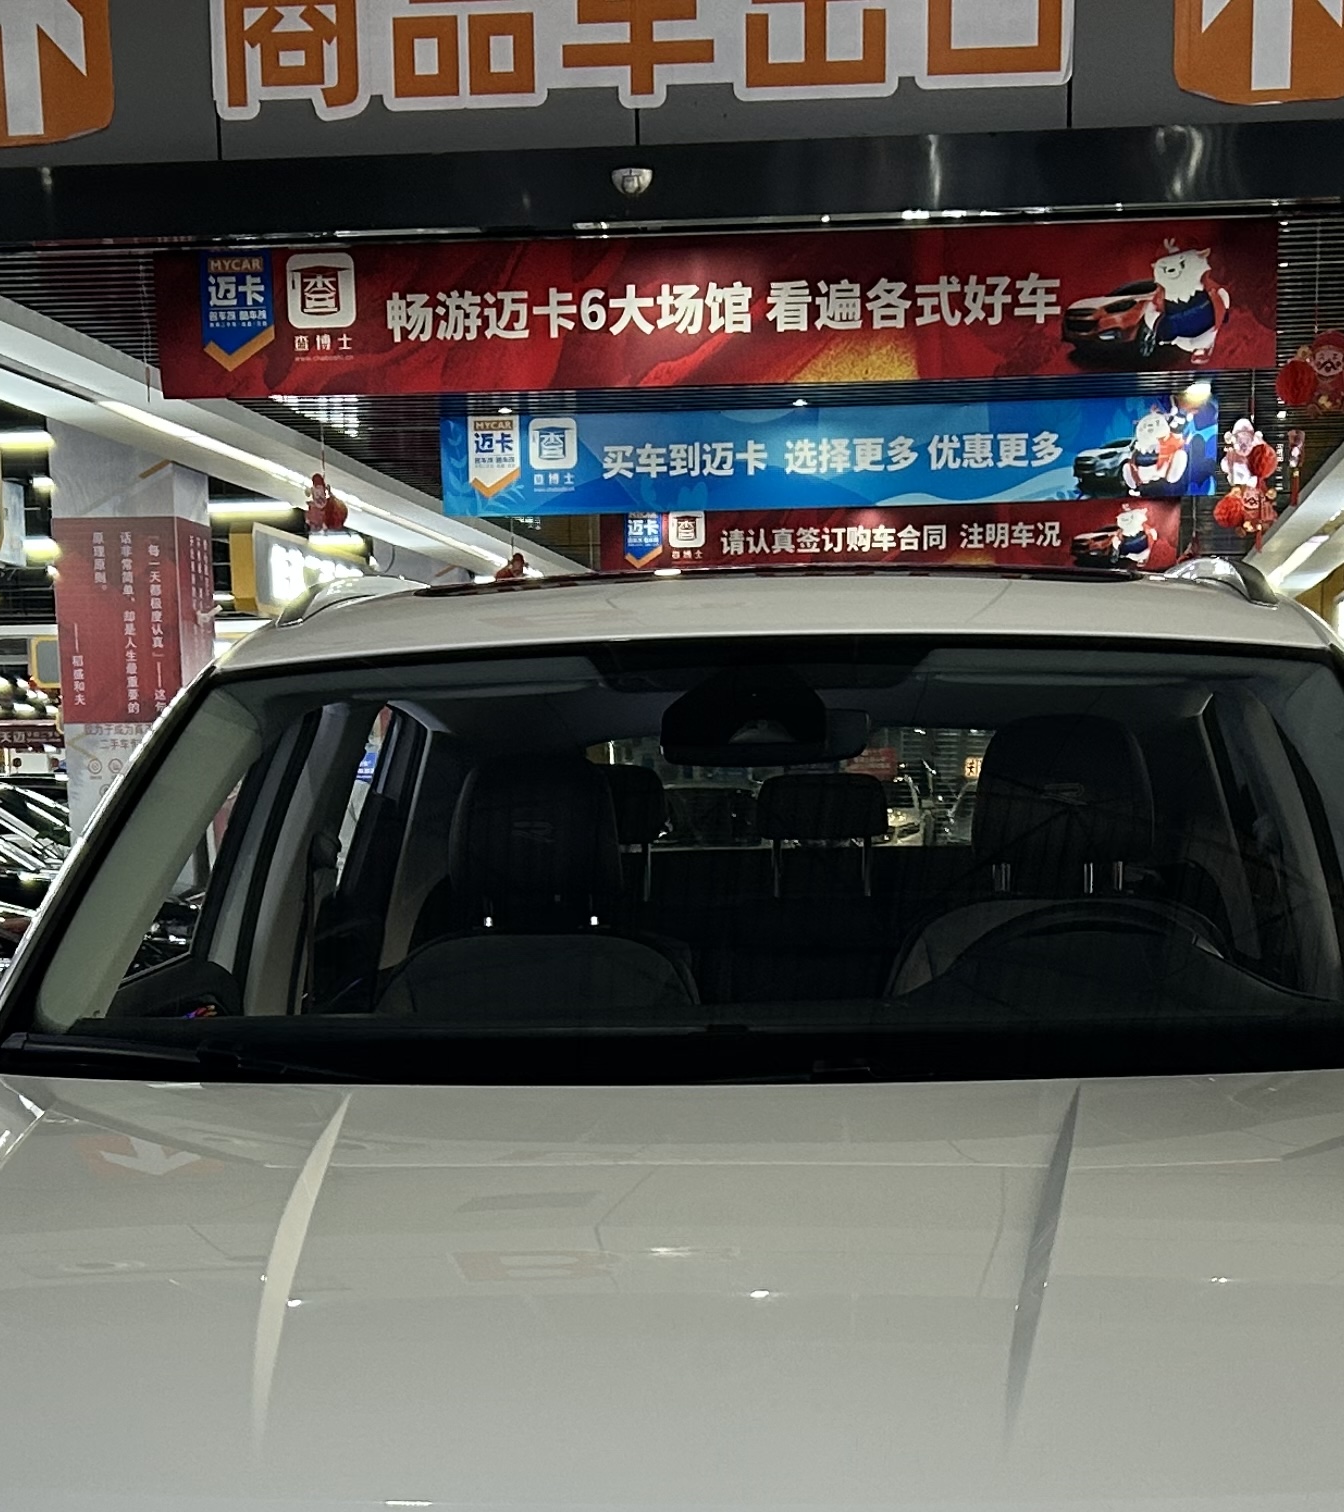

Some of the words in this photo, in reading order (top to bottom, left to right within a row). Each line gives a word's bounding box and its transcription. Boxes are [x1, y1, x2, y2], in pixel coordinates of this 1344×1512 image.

[224, 0, 1063, 109] 商品车出口
[209, 259, 263, 271] MYCAR
[208, 274, 265, 307] 迈卡
[386, 281, 752, 343] 畅游迈卡6大场馆
[766, 272, 1062, 332] 看遍各式好车
[294, 334, 353, 351] 查博士
[475, 420, 512, 430] MYCAR
[474, 432, 513, 453] 迈卡
[602, 441, 768, 480] 买车到迈卡
[785, 435, 918, 474] 选择更多
[928, 431, 1064, 472] 优惠更多
[627, 519, 660, 536] 迈卡
[721, 523, 947, 556] 请认真签订购车合同
[959, 522, 1062, 549] 注明车况
